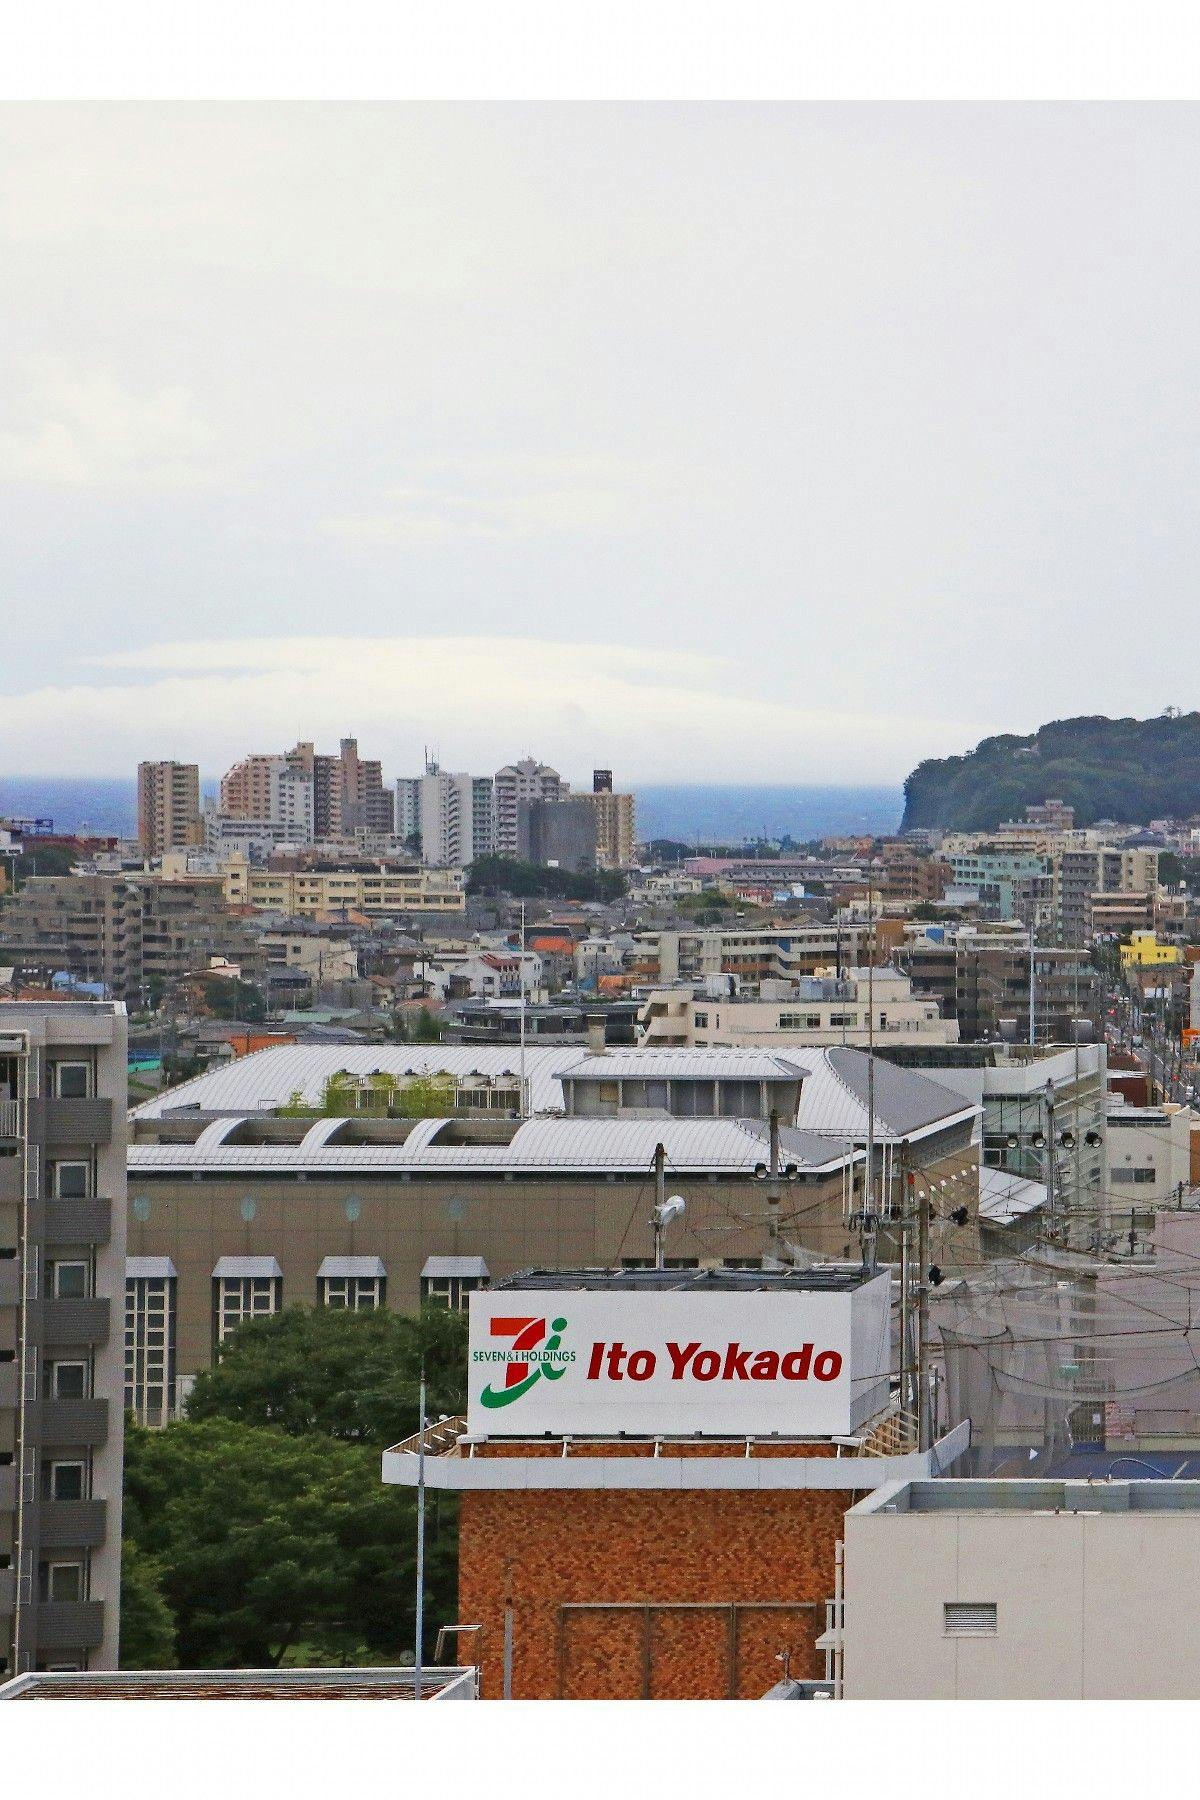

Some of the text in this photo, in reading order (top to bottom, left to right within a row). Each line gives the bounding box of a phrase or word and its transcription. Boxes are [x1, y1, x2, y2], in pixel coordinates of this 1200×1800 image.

[522, 1351, 576, 1362] HOLDINGS
[587, 1343, 842, 1381] Ito Yokado
